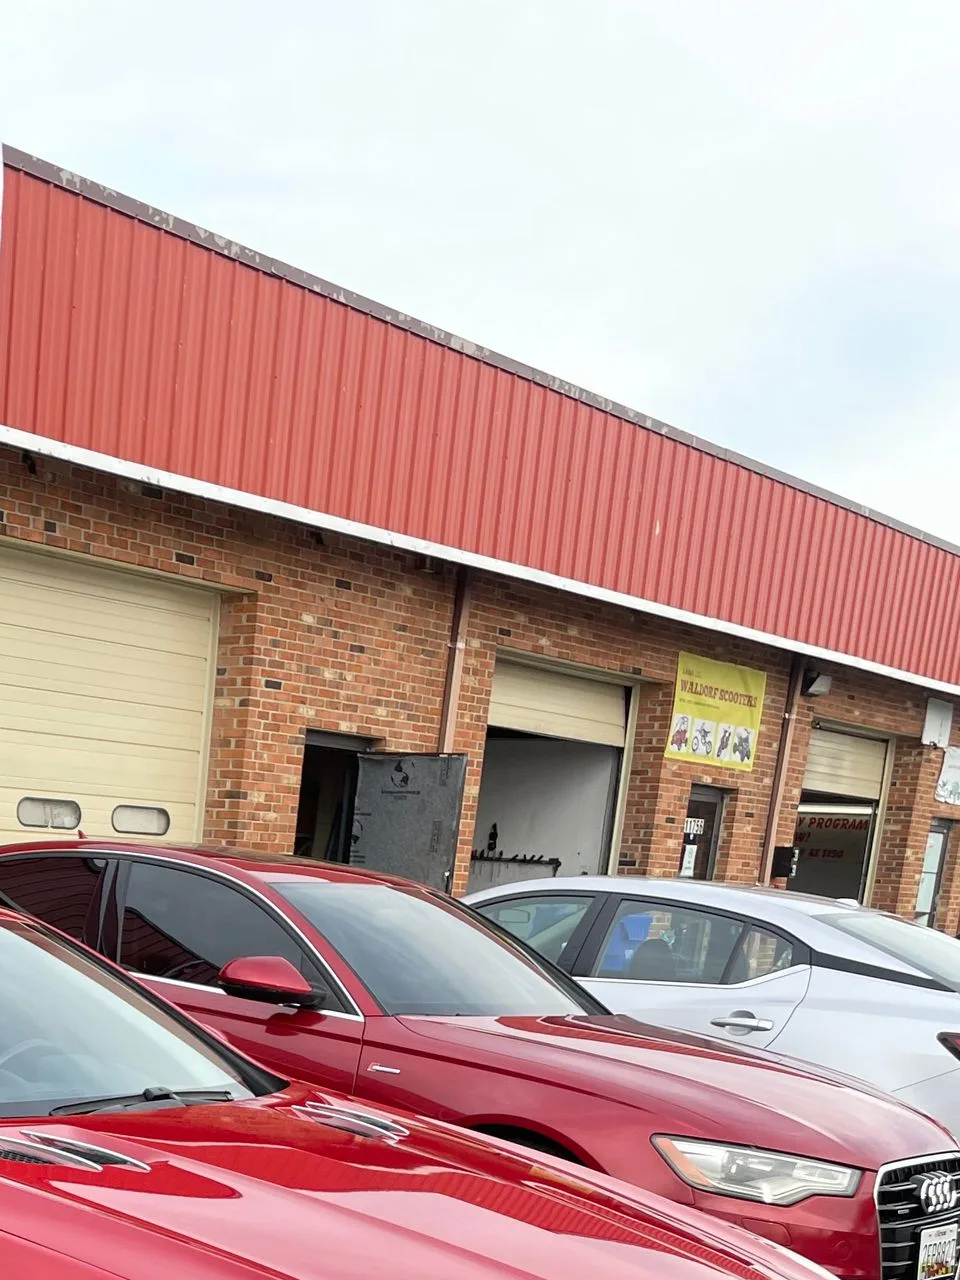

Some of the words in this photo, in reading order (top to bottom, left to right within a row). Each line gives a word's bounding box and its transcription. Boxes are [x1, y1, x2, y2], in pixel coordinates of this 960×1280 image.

[680, 679, 719, 699] WALDORF
[719, 688, 758, 708] SCOOTERS
[808, 816, 869, 831] PROGRAM
